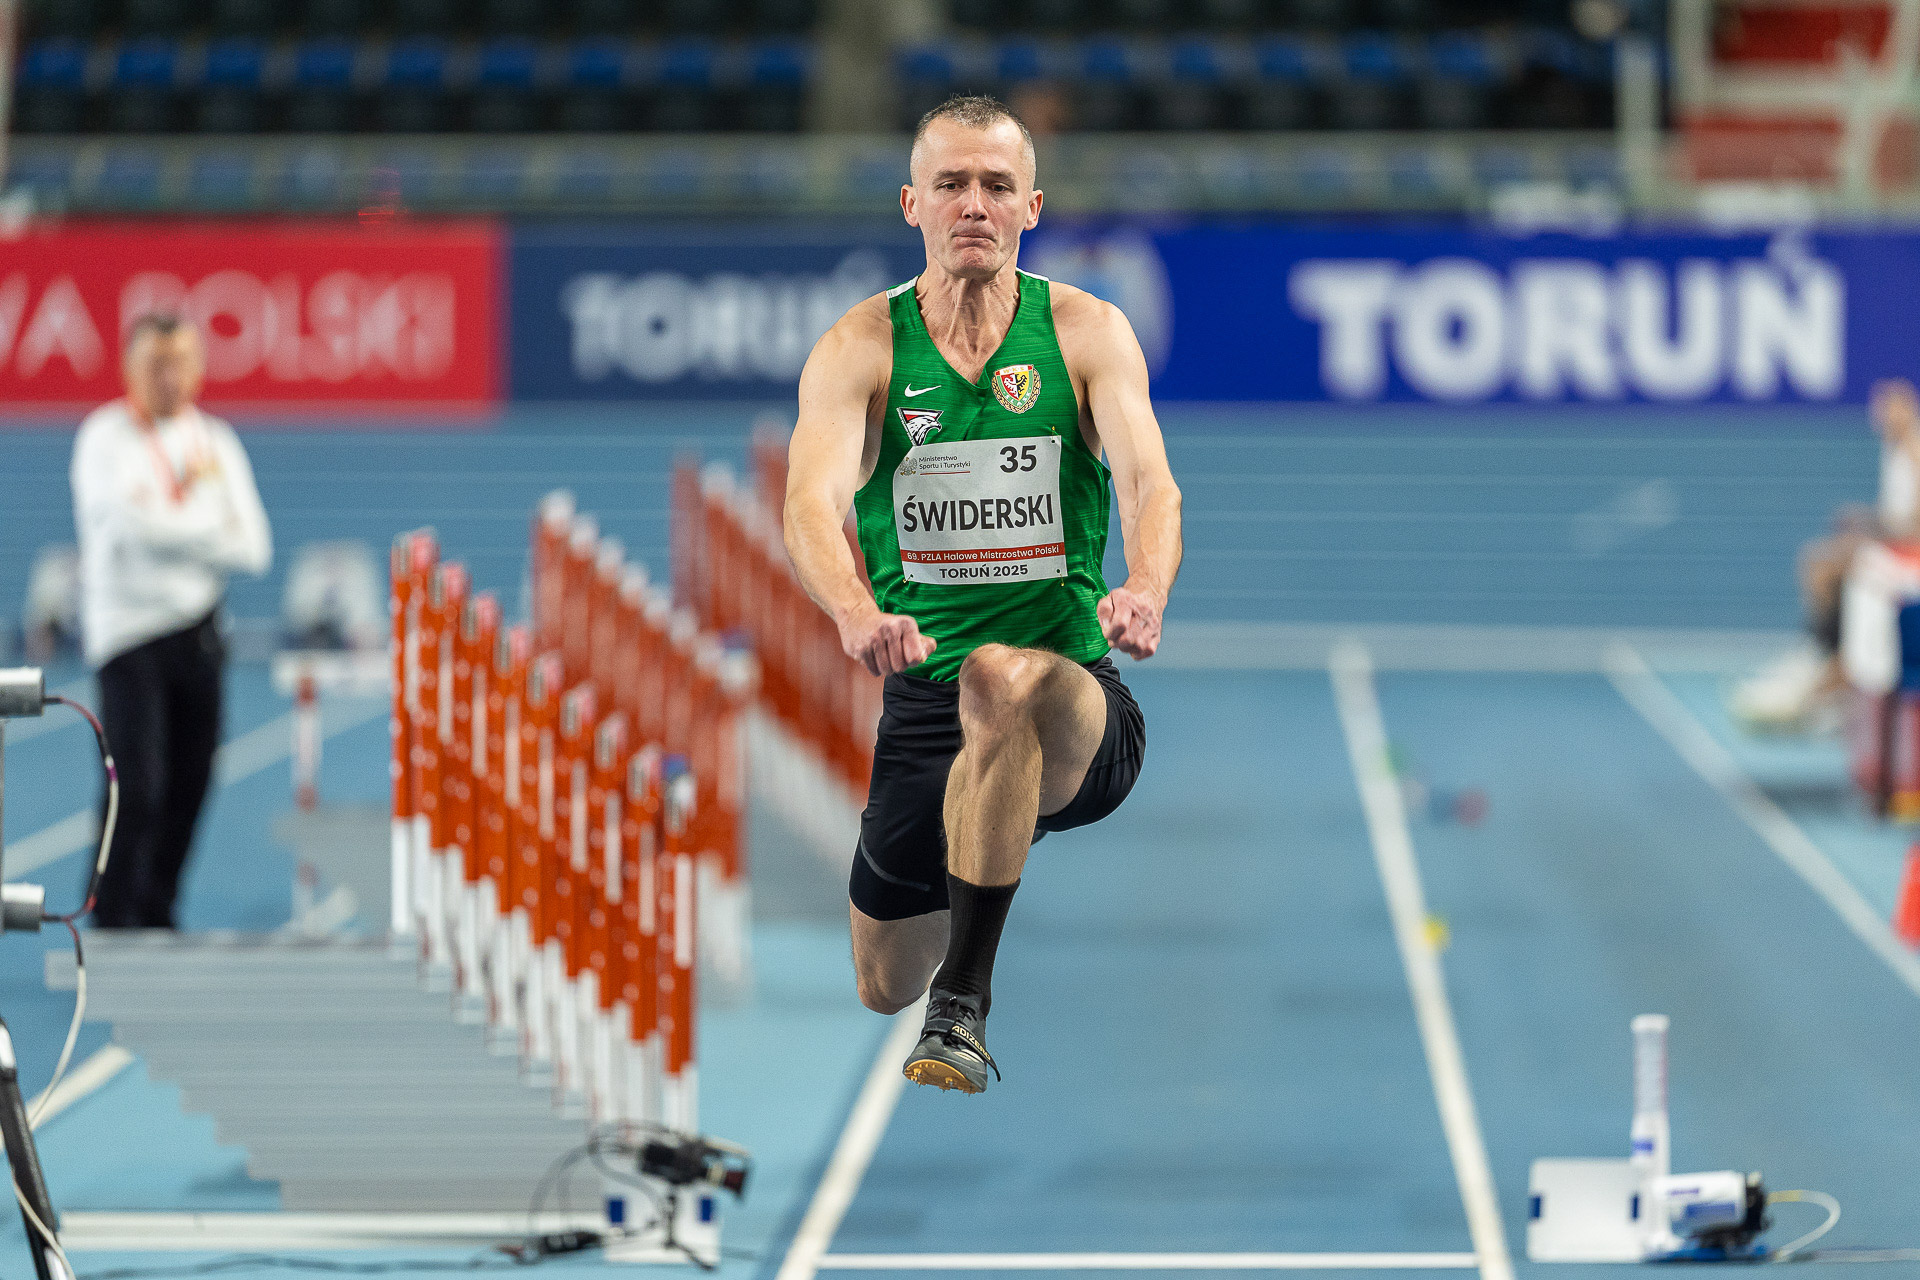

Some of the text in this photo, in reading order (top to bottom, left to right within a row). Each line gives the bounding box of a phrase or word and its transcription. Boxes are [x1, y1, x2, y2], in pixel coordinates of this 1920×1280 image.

[1288, 230, 1846, 402] TORUŃ
[944, 461, 971, 469] Turystyki
[1000, 445, 1037, 473] 35
[902, 494, 1054, 532] ŚWIDERSKI
[907, 544, 1060, 561] 69. PZLA Halowe Mistrzostwa Polski
[938, 563, 1029, 579] TORUŃ 2025
